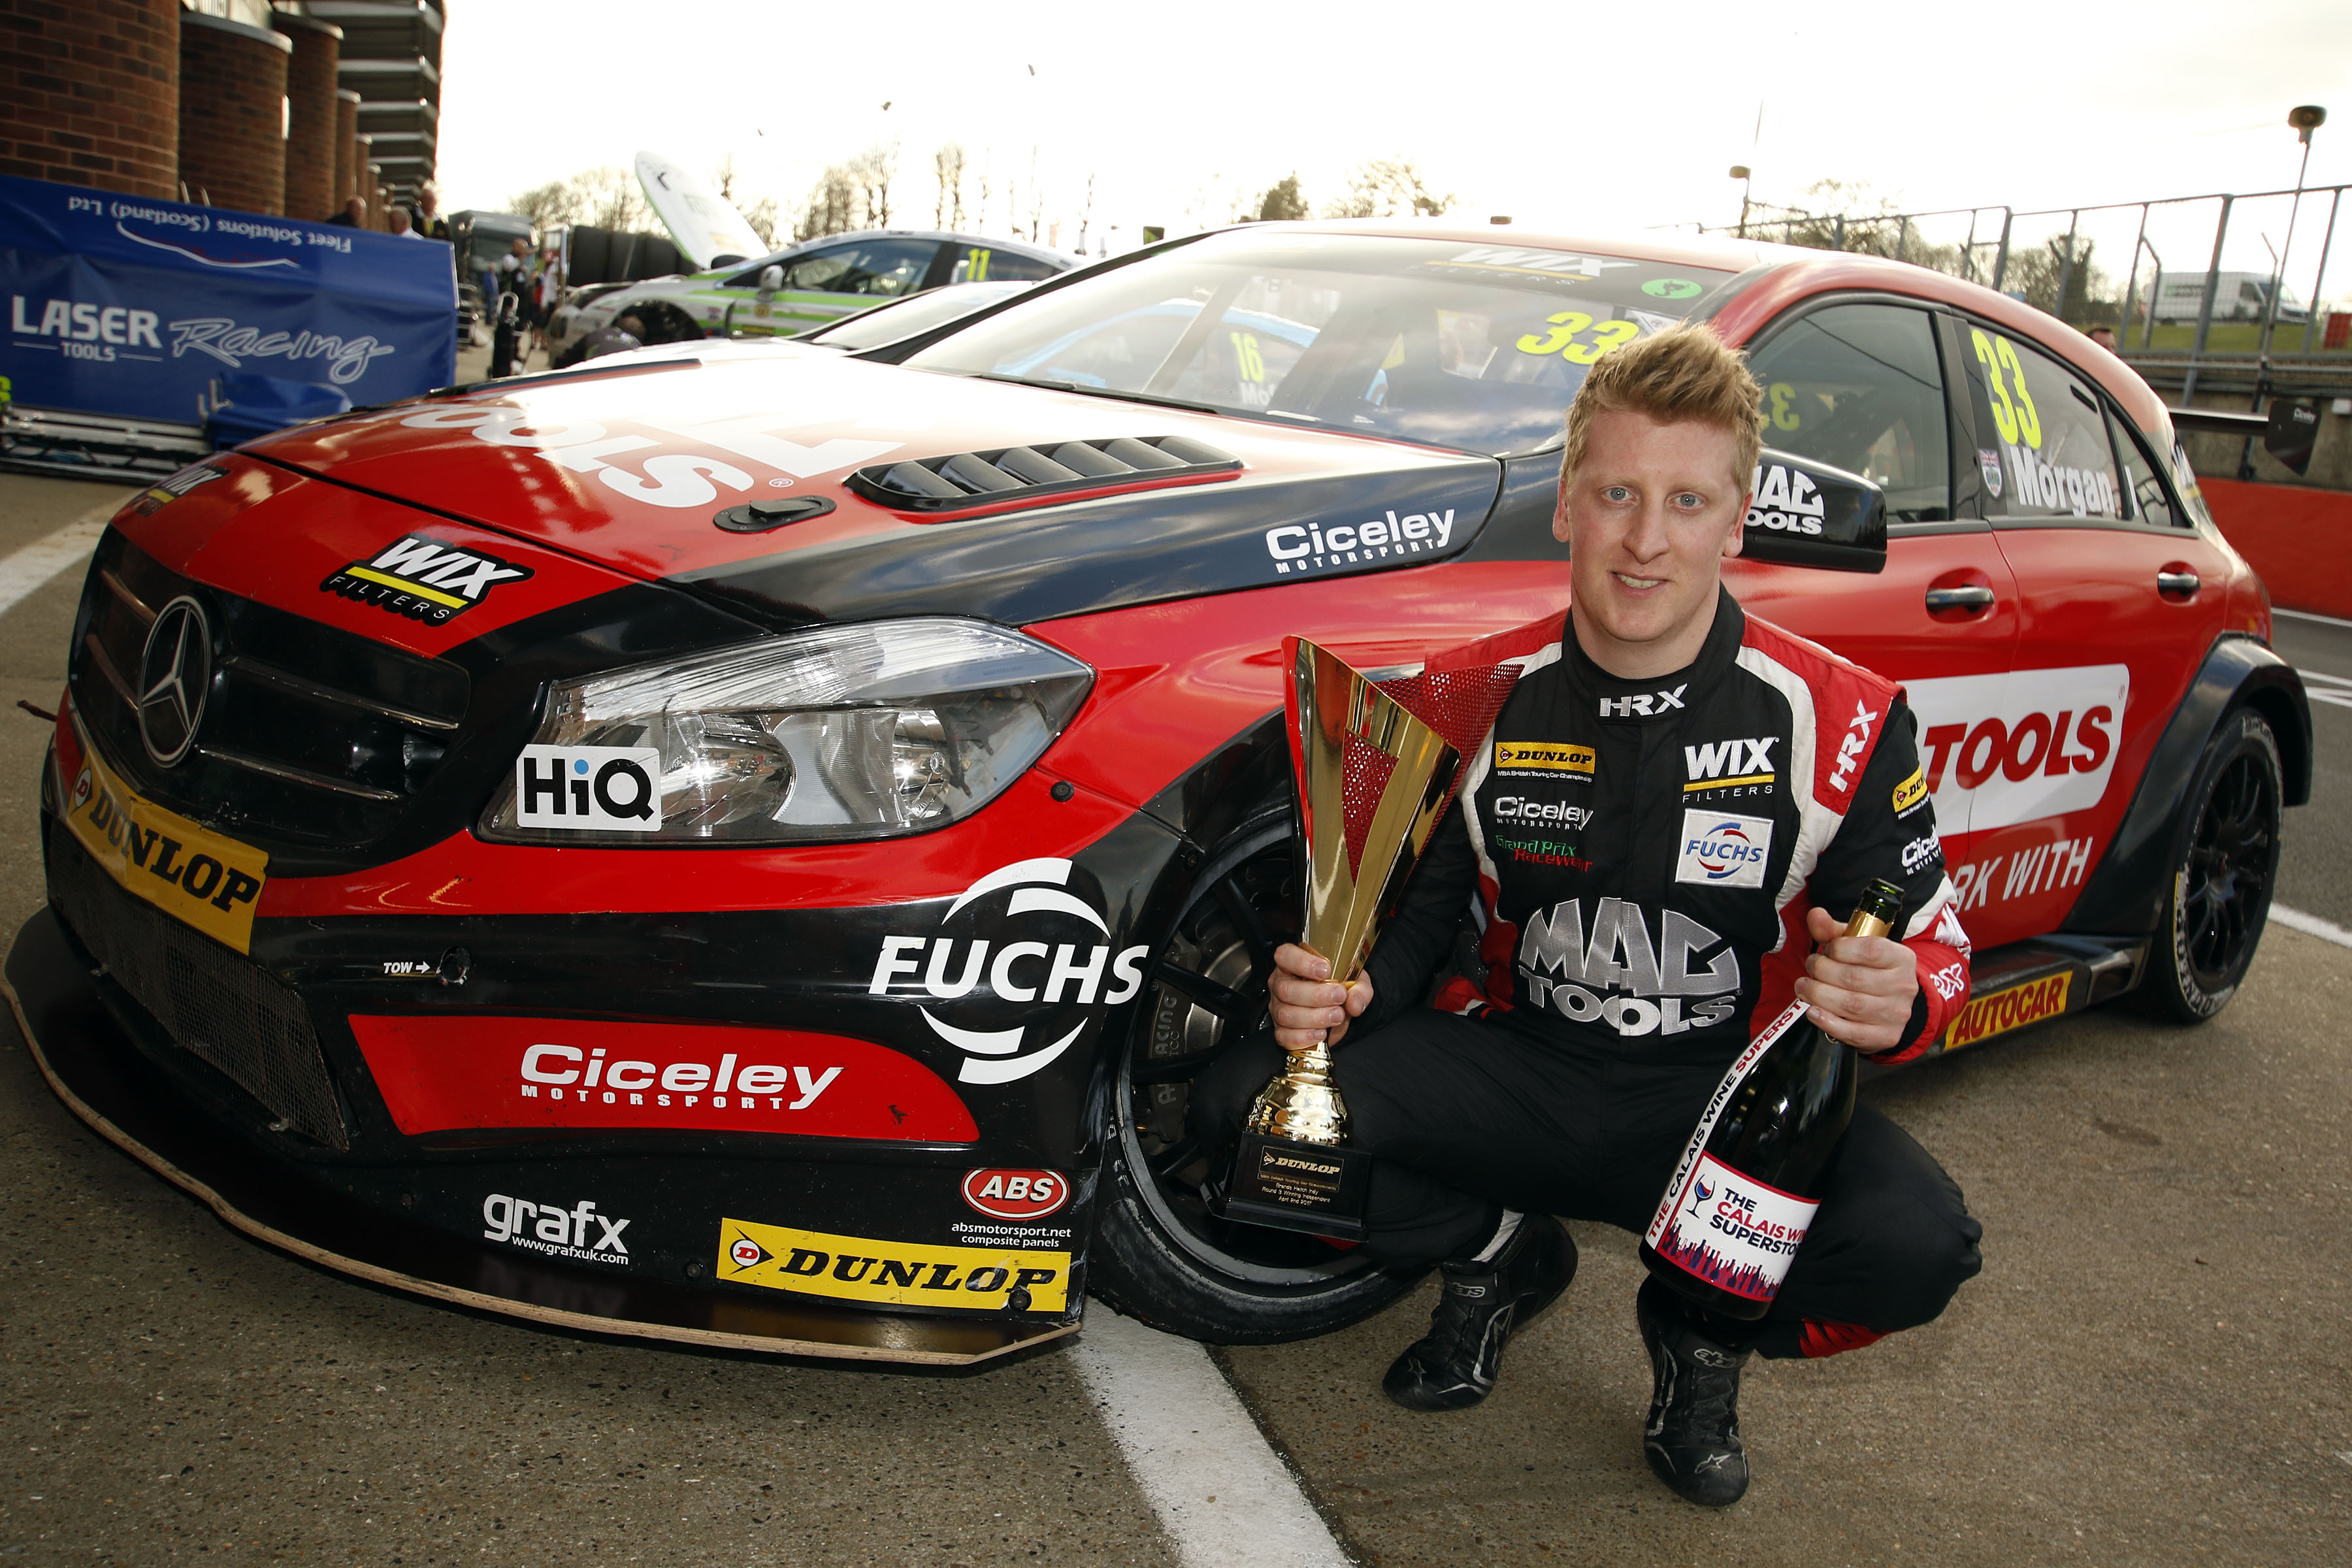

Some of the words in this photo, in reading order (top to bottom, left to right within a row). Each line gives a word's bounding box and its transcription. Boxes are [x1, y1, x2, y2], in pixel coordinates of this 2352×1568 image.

[68, 196, 102, 216] Ltd
[110, 201, 210, 233] (Scotland)
[216, 219, 302, 247] Solutions
[307, 232, 351, 253] Fleet
[967, 248, 991, 281] 11
[1450, 249, 1639, 276] WIX
[12, 295, 163, 349] LASER
[1516, 312, 1639, 365] 33
[61, 341, 116, 363] TOOLS
[169, 318, 395, 384] Racing
[1231, 332, 1264, 383] 16
[1971, 329, 2042, 449] 33
[2010, 446, 2115, 518] Morgan
[1266, 509, 1455, 560] Ciceley
[1744, 508, 1823, 536] OOLS
[370, 538, 524, 599] WIX
[1275, 538, 1434, 574] MOTORSPORT
[329, 575, 449, 619] FILTERS
[1599, 683, 1688, 717] HRX
[1516, 751, 1592, 764] DUNLOP
[1684, 737, 1775, 780] WIX
[1829, 699, 1878, 792] HRX
[1924, 705, 2112, 794] TOOLS
[524, 758, 655, 821] HiQ
[1682, 785, 1773, 804] FILTERS
[1494, 796, 1593, 831] Ciceley
[1496, 818, 1578, 830] MOTORSPORT
[89, 786, 261, 913] DUNLOP
[1495, 834, 1539, 854] Grand
[1541, 840, 1577, 857] Prix
[1514, 847, 1593, 872] Racewear
[1686, 839, 1763, 862] FUCHS
[1950, 856, 2003, 914] RK
[2002, 836, 2093, 901] WITH
[1519, 897, 1741, 997] MAC
[384, 962, 413, 974] TOW
[868, 936, 1150, 1005] FUCHS
[1518, 964, 1737, 1037] TOOLS
[1953, 976, 2065, 1045] AUTOCAR
[521, 1044, 845, 1109] Ciceley
[521, 1085, 783, 1109] MOTORSPORT
[1275, 1157, 1341, 1174] DUNLOP
[1648, 1200, 1671, 1238] THE
[1669, 1128, 1705, 1198] CALAIS
[1703, 1073, 1738, 1124] WINE
[977, 1175, 1054, 1201] ABS
[1283, 1190, 1301, 1199] Winning
[1725, 1187, 1757, 1213] THE
[483, 1194, 631, 1254] grafx
[951, 1222, 1071, 1238] absmotorsport.net
[1718, 1201, 1786, 1239] CALAIS
[512, 1235, 629, 1266] www.grafxuk.com
[962, 1235, 1021, 1246] composite
[1022, 1239, 1060, 1248] panels
[779, 1247, 1057, 1294] DUNLOP
